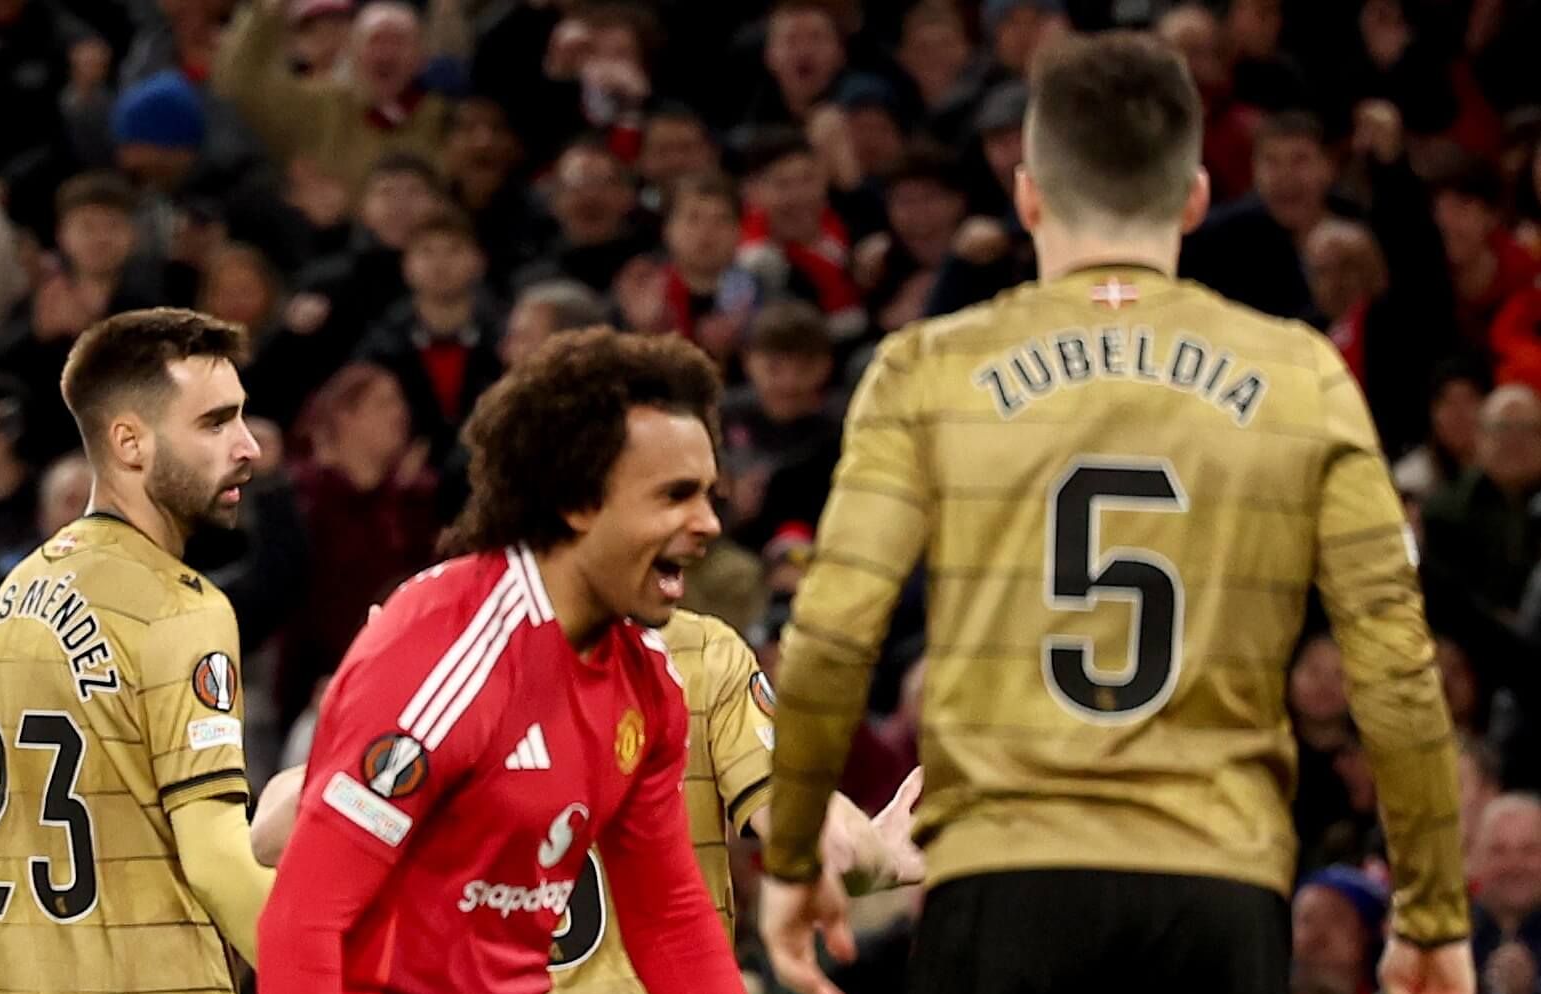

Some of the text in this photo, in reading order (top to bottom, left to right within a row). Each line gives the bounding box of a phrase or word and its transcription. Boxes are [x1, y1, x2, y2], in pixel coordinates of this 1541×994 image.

[974, 326, 1266, 426] ZUBELDIA
[17, 572, 120, 702] MÉNDEZ
[1041, 454, 1189, 727] 5
